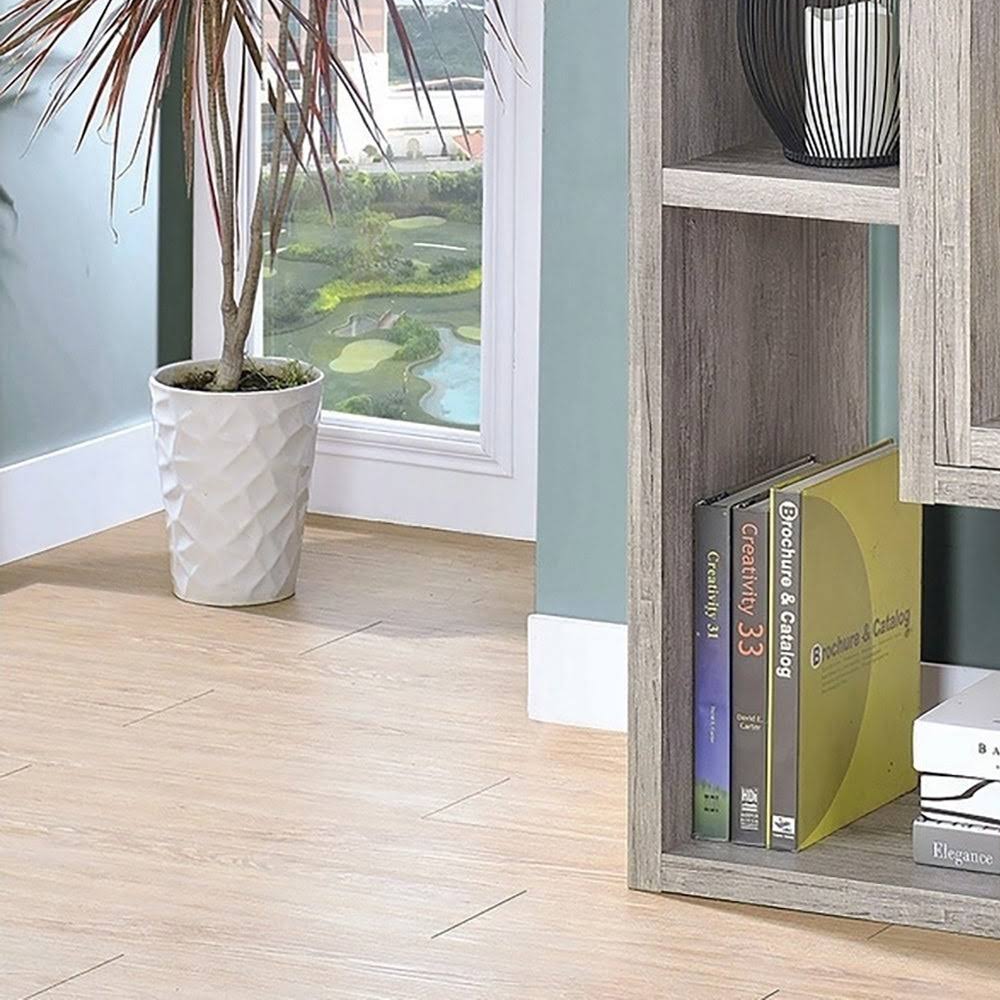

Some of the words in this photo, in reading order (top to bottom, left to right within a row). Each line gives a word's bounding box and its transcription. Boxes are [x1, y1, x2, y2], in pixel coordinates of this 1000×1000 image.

[738, 523, 758, 616] Creativity
[778, 500, 799, 588] Brochure
[705, 551, 720, 621] Creativity
[780, 592, 796, 605] &
[707, 624, 719, 639] 31
[738, 622, 764, 657] 33
[775, 611, 796, 679] Catalog
[810, 632, 860, 669] Brochure
[873, 608, 911, 638] Catalog
[932, 841, 994, 867] Elegance
